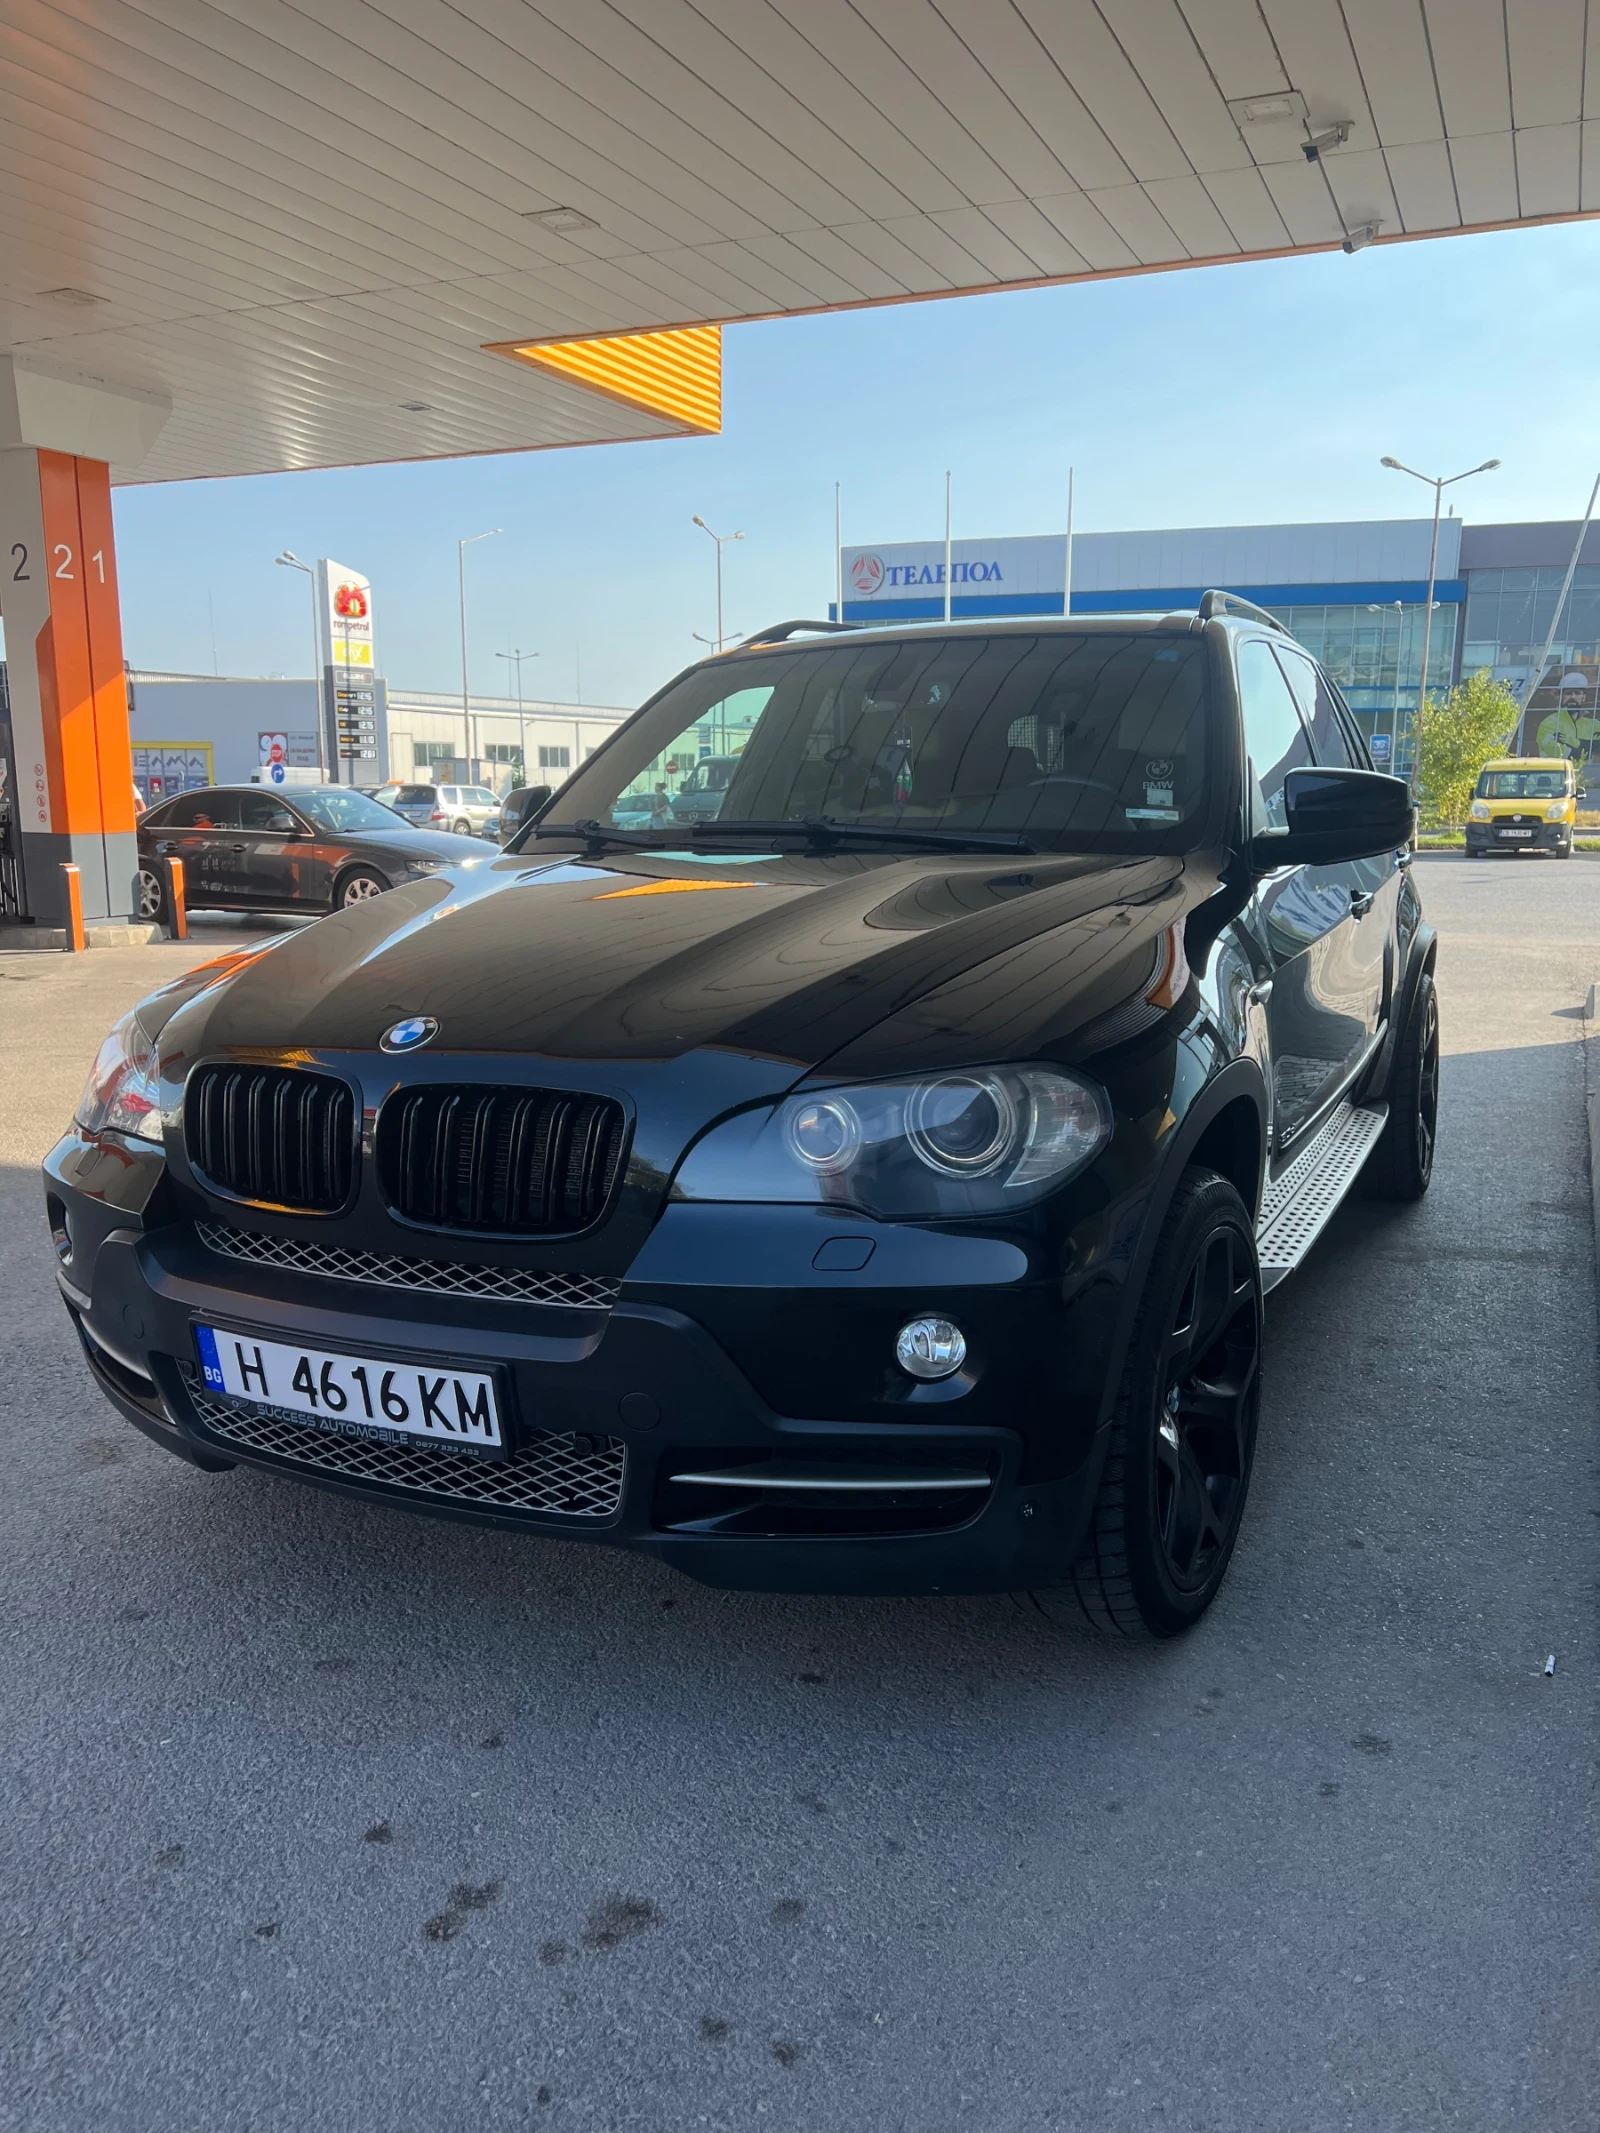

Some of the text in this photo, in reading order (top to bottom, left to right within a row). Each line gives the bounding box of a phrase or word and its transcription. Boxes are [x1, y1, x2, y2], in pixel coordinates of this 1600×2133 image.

[11, 543, 30, 581] 2
[54, 544, 74, 579] 2
[92, 550, 105, 584] 1
[203, 1365, 223, 1384] BG
[234, 1341, 494, 1437] H 4616 KM
[257, 1404, 409, 1445] SUCCESS AUTOMOBILE
